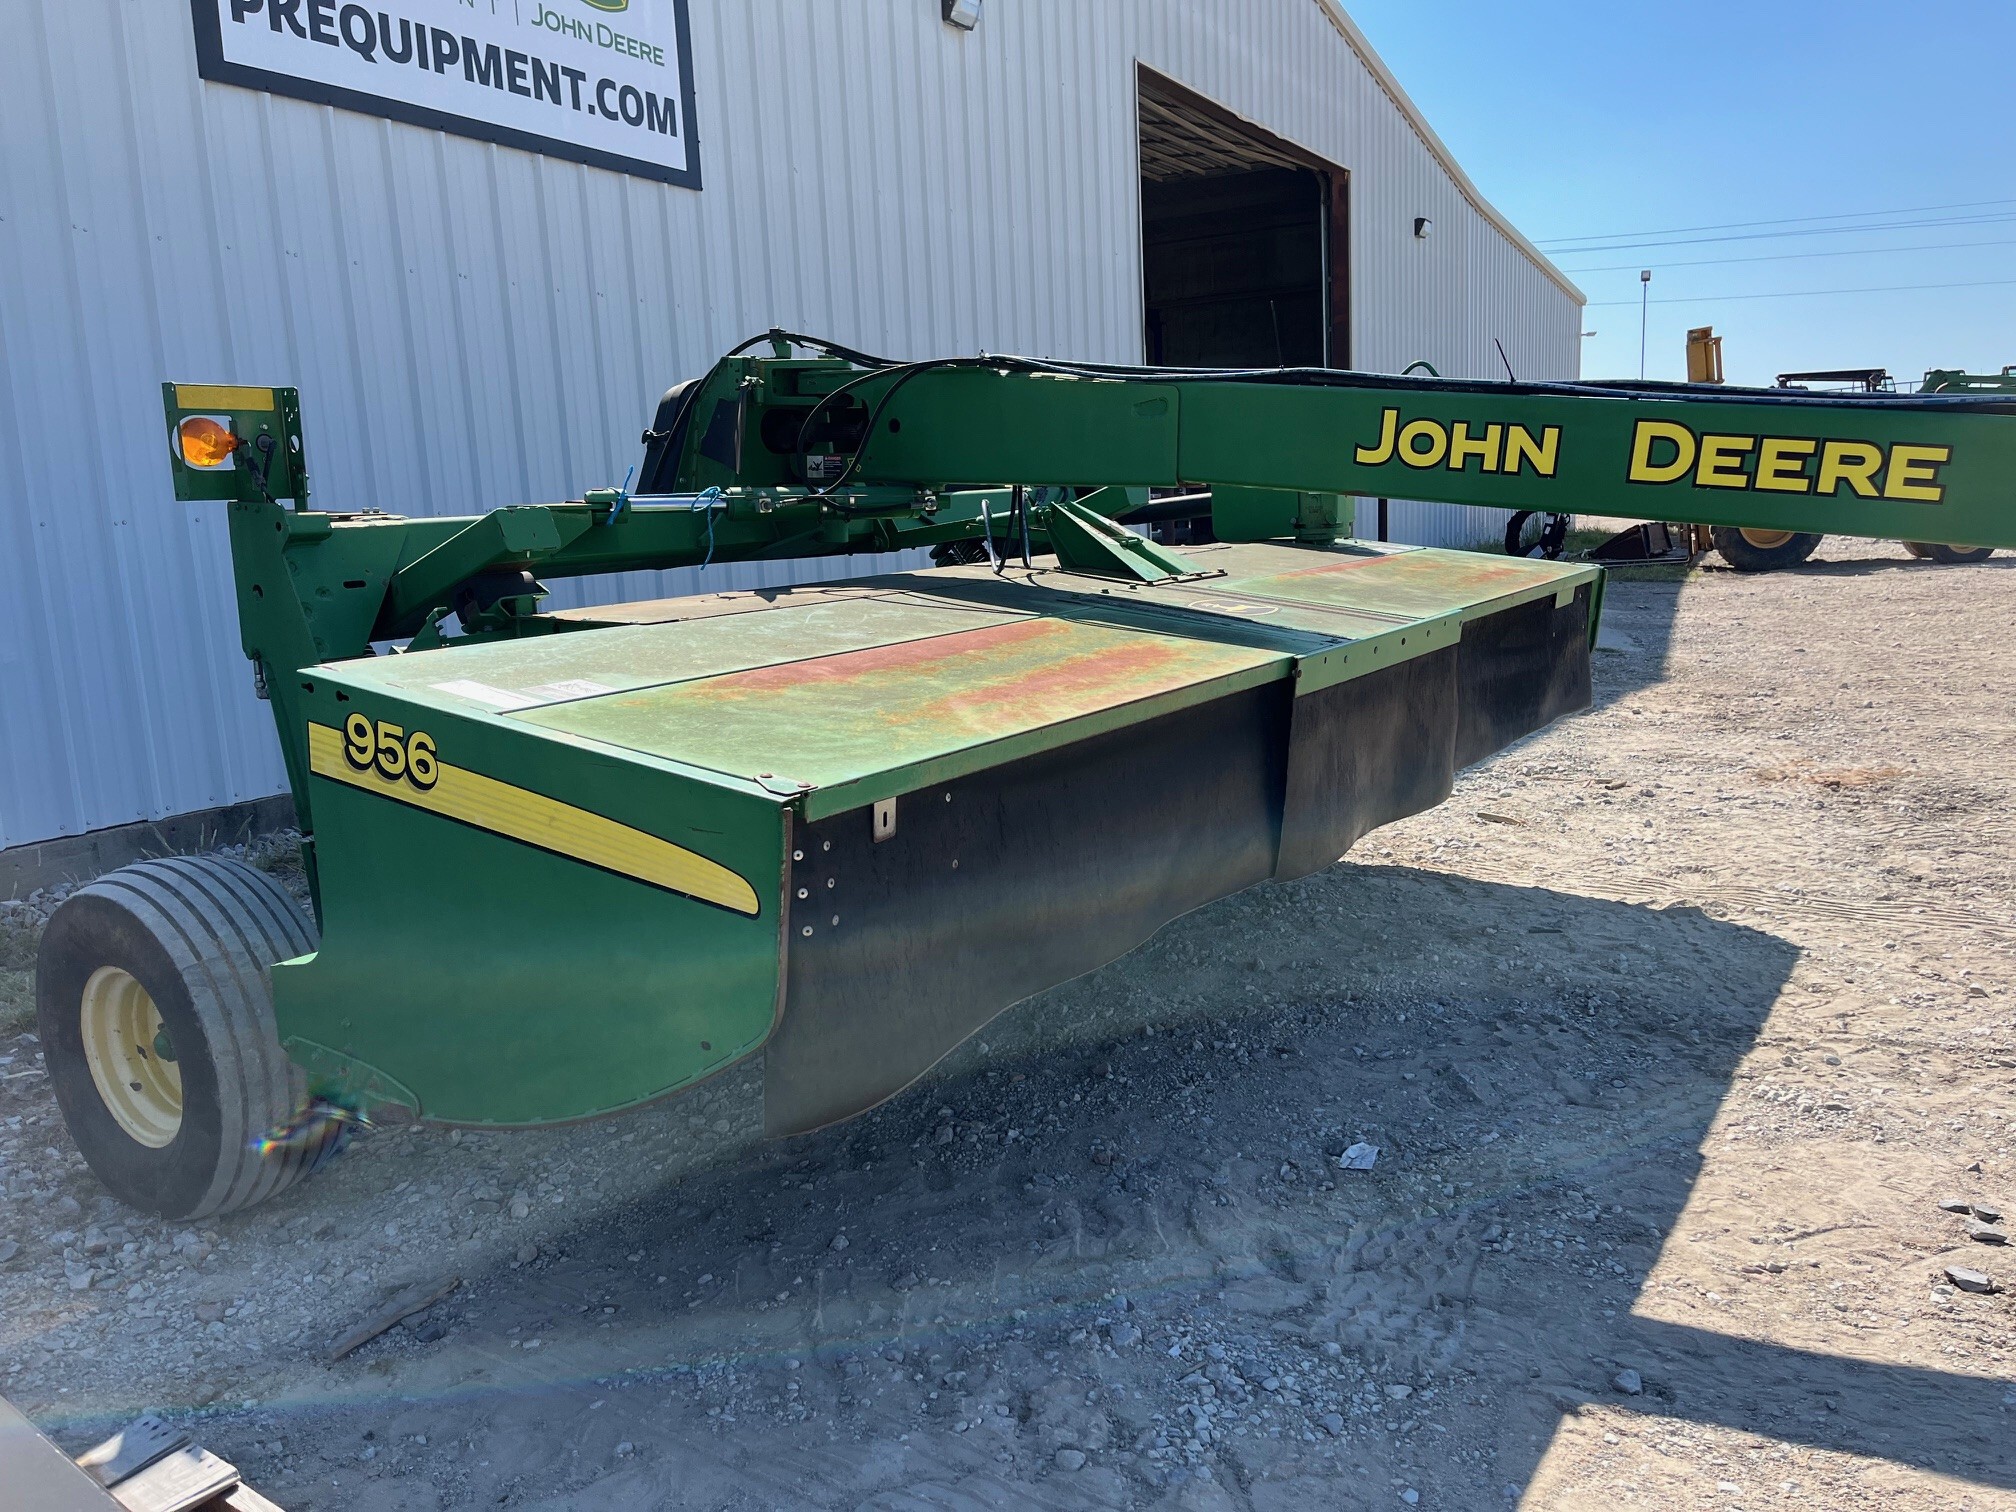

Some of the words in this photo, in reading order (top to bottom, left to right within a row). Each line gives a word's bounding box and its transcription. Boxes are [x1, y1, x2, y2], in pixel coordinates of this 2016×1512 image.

[531, 3, 593, 43] JOHN
[596, 22, 665, 67] DEERE
[1355, 407, 1560, 478] JOHN
[1630, 420, 1951, 501] DEERE
[344, 712, 438, 789] 956
